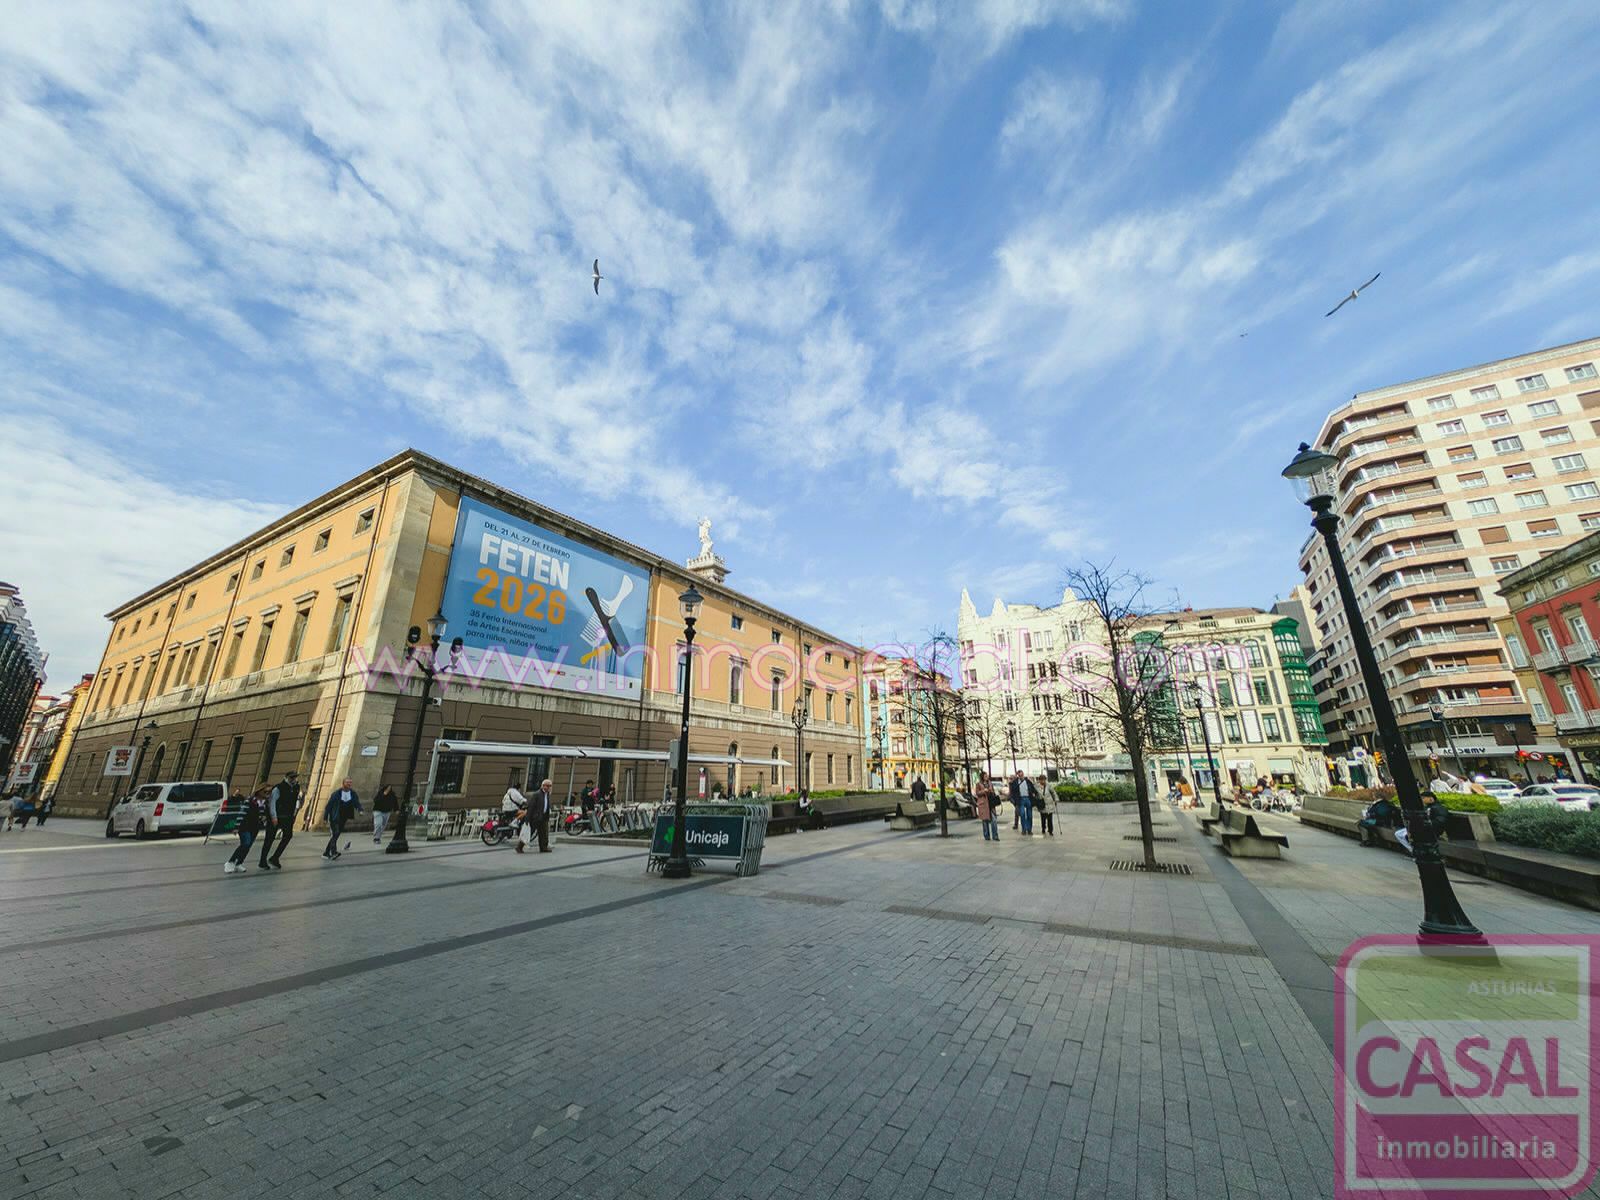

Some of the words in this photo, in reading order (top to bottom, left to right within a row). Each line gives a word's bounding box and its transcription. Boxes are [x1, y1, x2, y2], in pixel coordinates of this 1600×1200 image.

[484, 521, 498, 532] DEL
[500, 528, 509, 536] 21
[510, 532, 520, 540] AL
[522, 536, 531, 544] 27
[532, 540, 540, 548] DE
[542, 544, 570, 559] FEBRERO
[480, 532, 570, 590] FETEN
[472, 567, 568, 625] 2026
[465, 629, 486, 638] para
[467, 619, 479, 628] de
[480, 622, 500, 632] Artes
[470, 609, 480, 618] 35
[482, 612, 502, 623] Feria
[502, 616, 548, 634] Internacional
[685, 830, 730, 848] Unicaja
